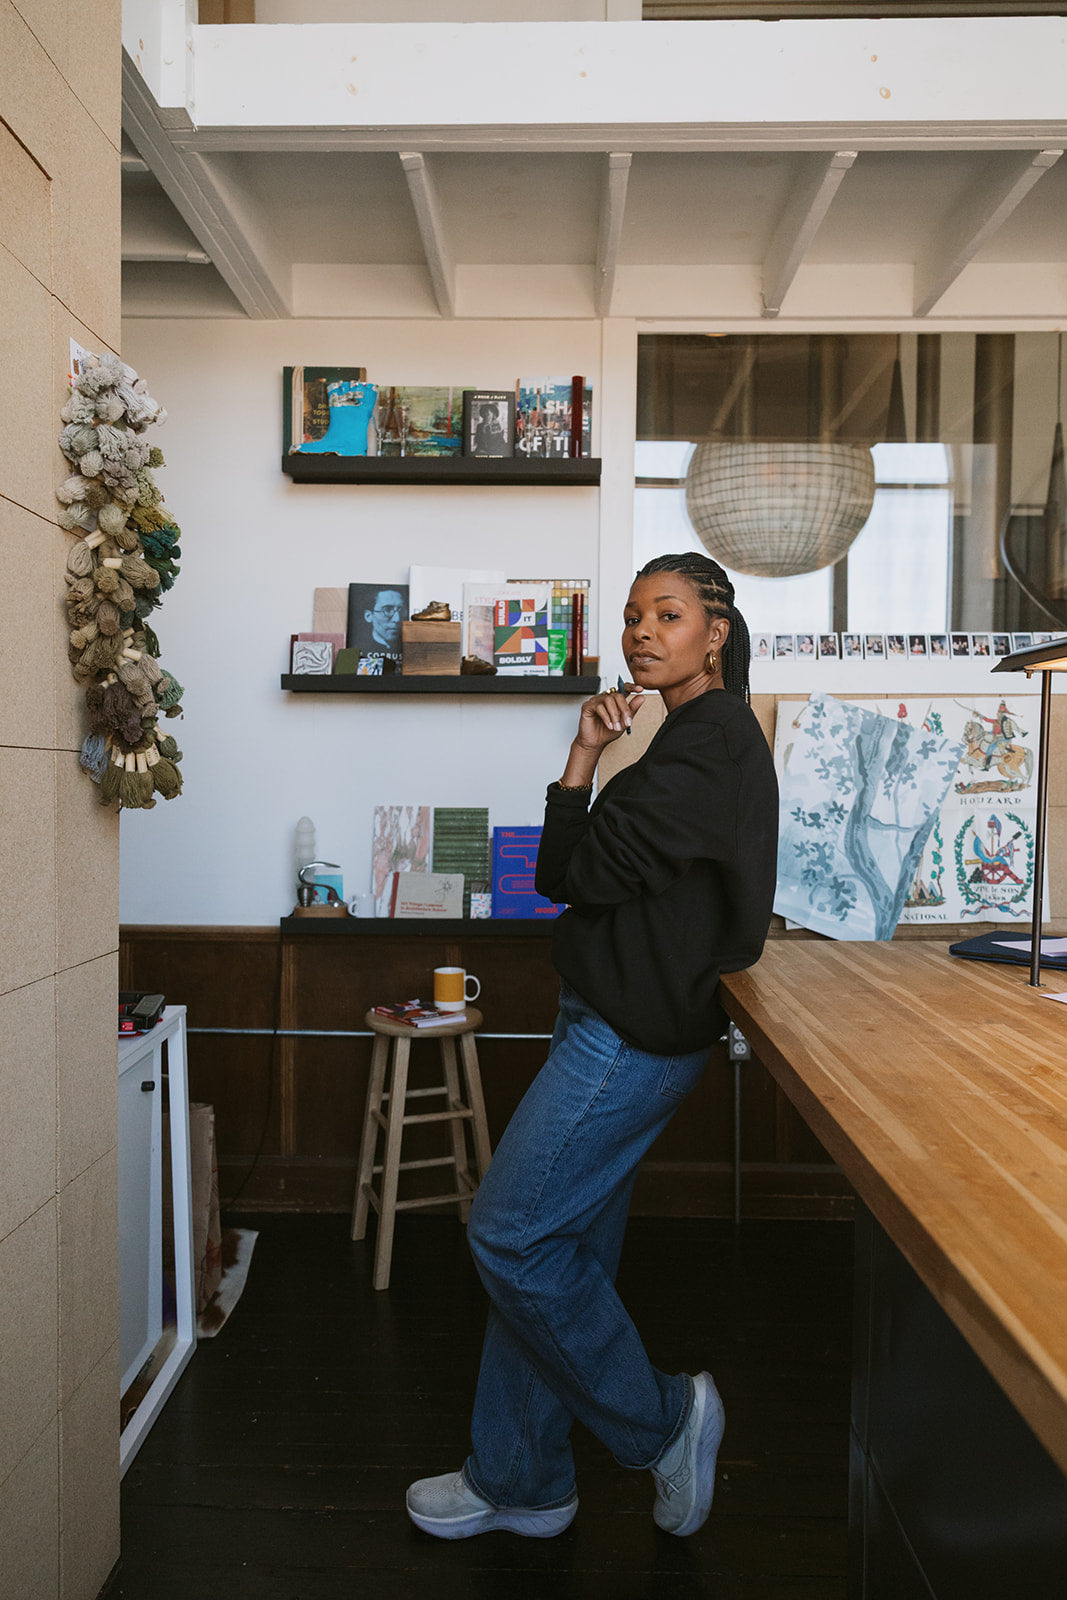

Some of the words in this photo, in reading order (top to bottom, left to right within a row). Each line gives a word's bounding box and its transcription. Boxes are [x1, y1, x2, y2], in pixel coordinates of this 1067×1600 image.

[523, 381, 555, 394] THE
[498, 601, 506, 625] BUILD
[499, 655, 532, 664] BOLDLY
